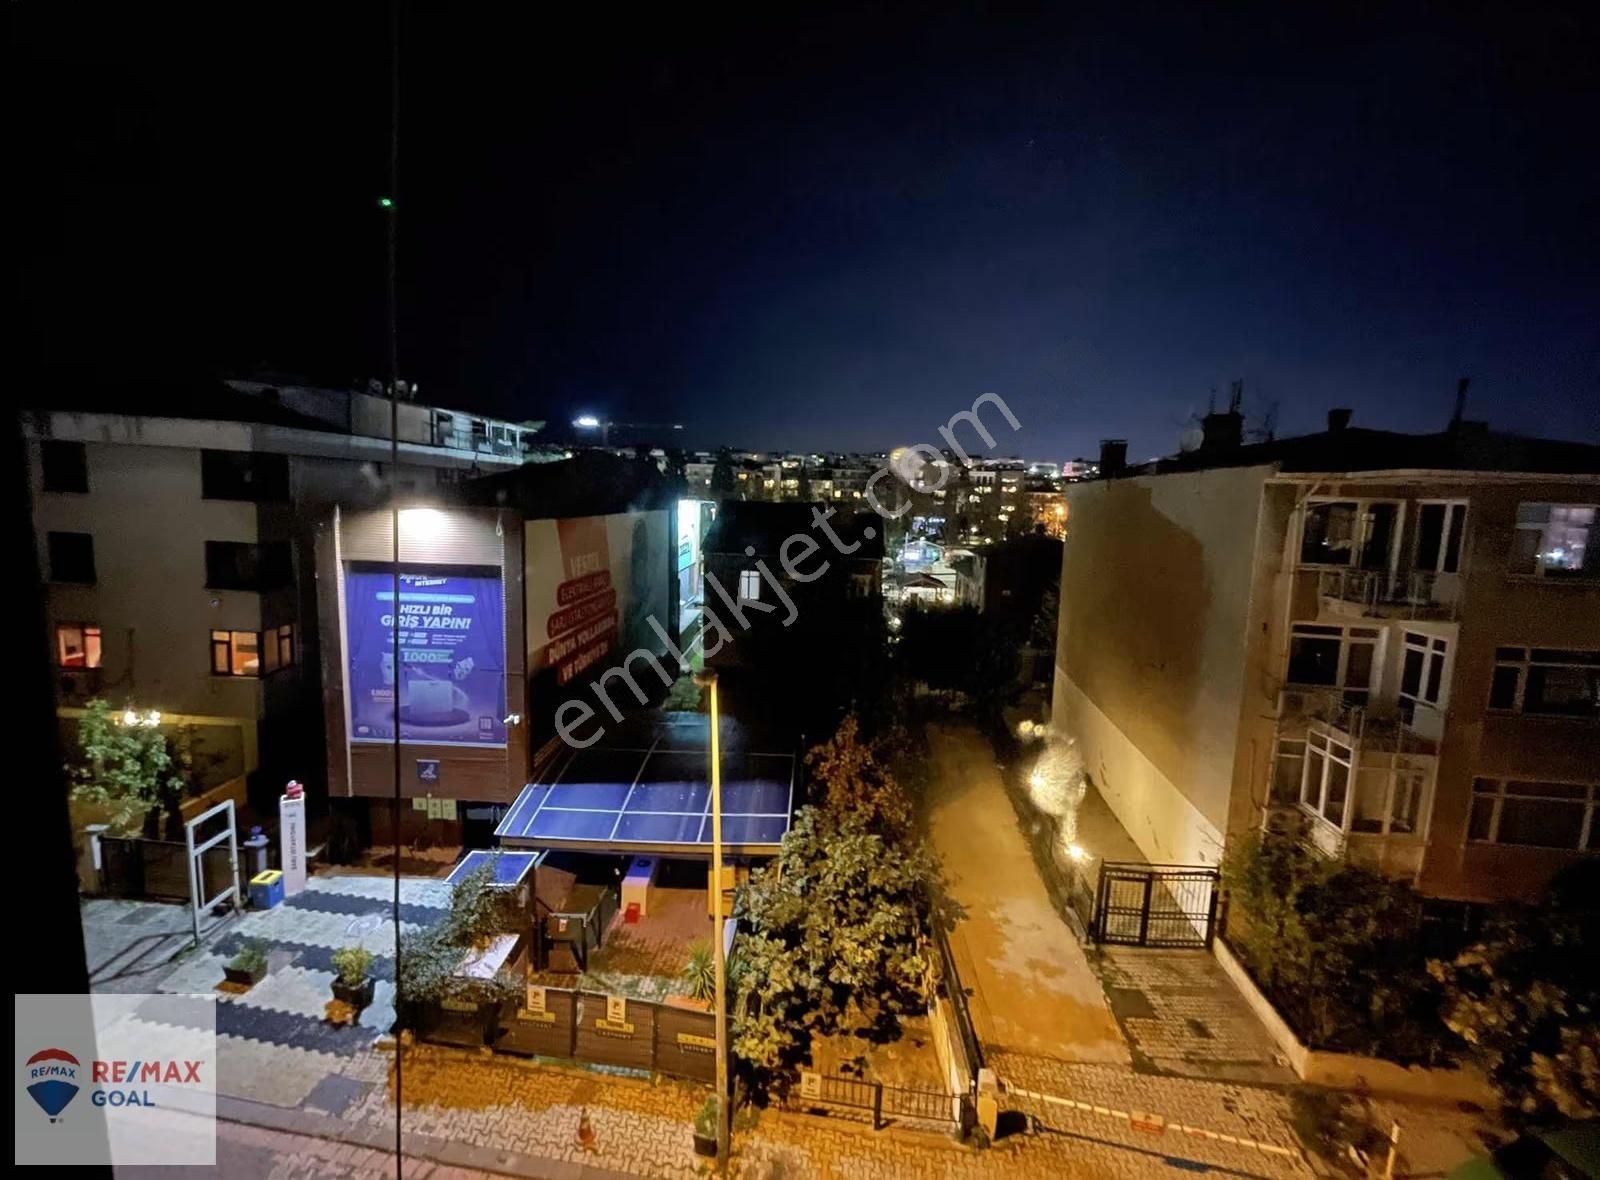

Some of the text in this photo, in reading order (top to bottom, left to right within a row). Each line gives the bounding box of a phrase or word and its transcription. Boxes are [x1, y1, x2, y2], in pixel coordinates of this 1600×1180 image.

[400, 603, 452, 615] HIZLI BİR
[423, 616, 471, 629] YAPIN!
